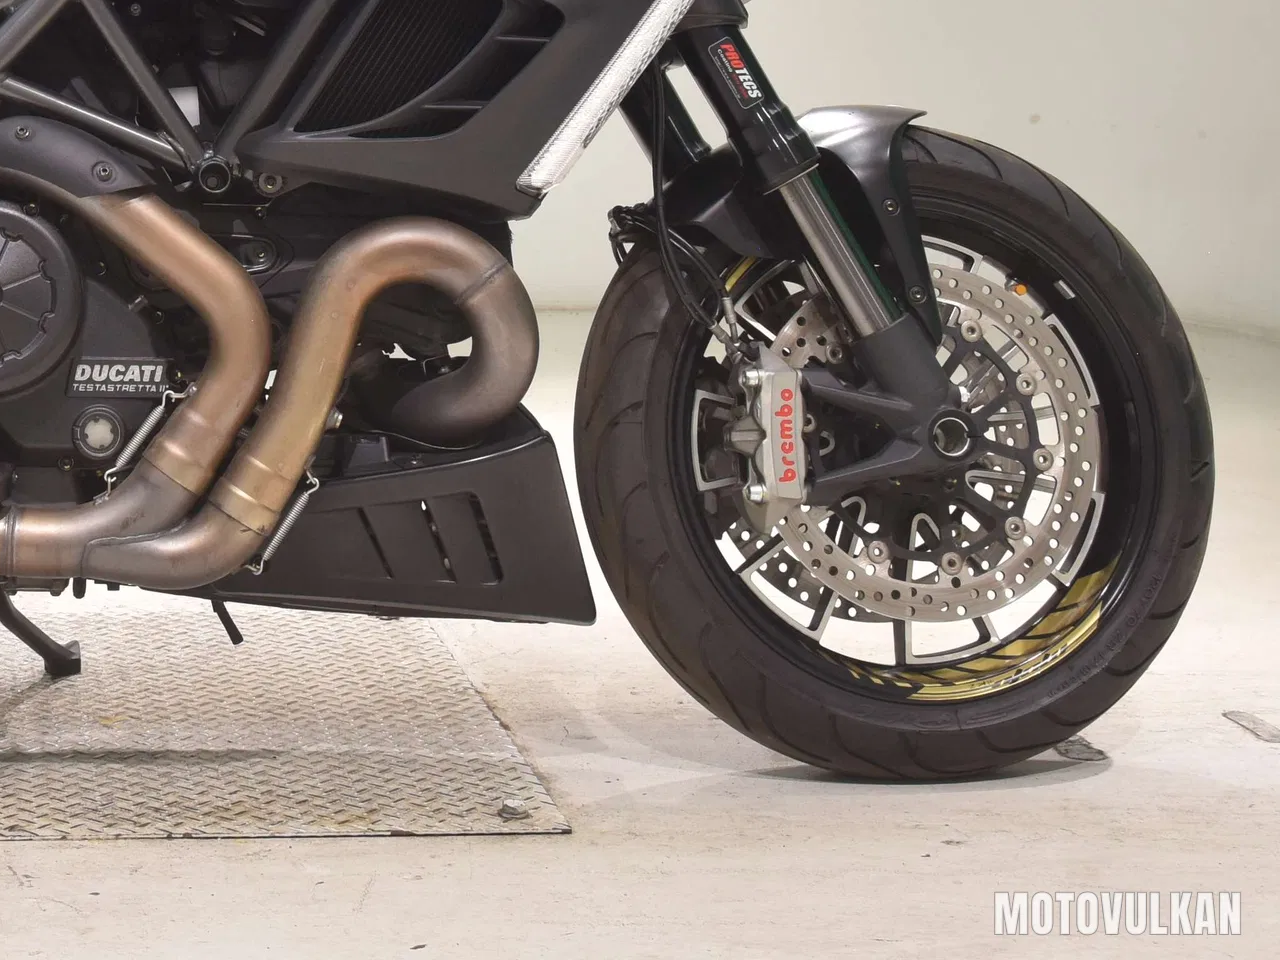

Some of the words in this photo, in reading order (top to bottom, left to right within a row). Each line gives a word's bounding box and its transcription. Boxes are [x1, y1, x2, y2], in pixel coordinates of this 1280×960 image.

[719, 43, 762, 98] PROTECS
[72, 383, 157, 392] TESTASTRETTA
[74, 364, 163, 382] DUCATI
[775, 388, 797, 483] brembo
